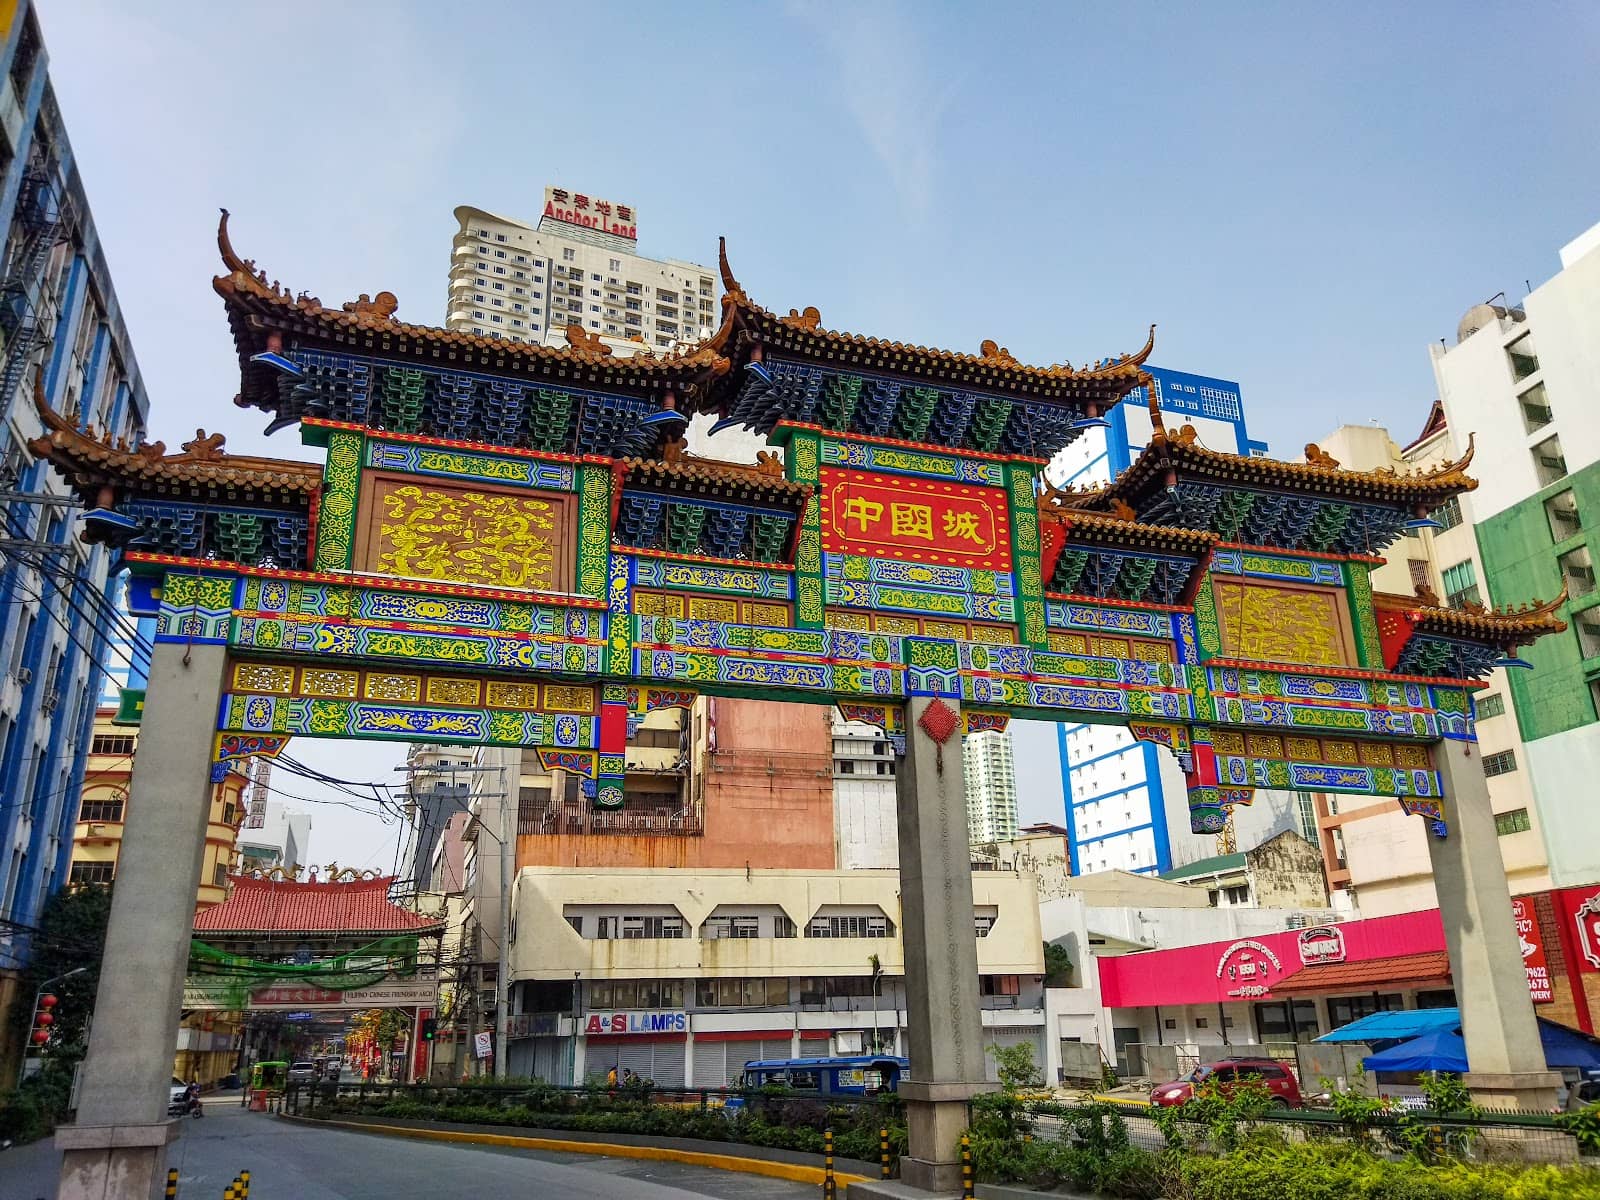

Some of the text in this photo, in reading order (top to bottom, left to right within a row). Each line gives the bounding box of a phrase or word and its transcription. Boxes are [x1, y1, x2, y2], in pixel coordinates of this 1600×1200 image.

[544, 200, 598, 228] Anchor
[842, 496, 986, 545] 中國城
[630, 1013, 685, 1032] LAMPS
